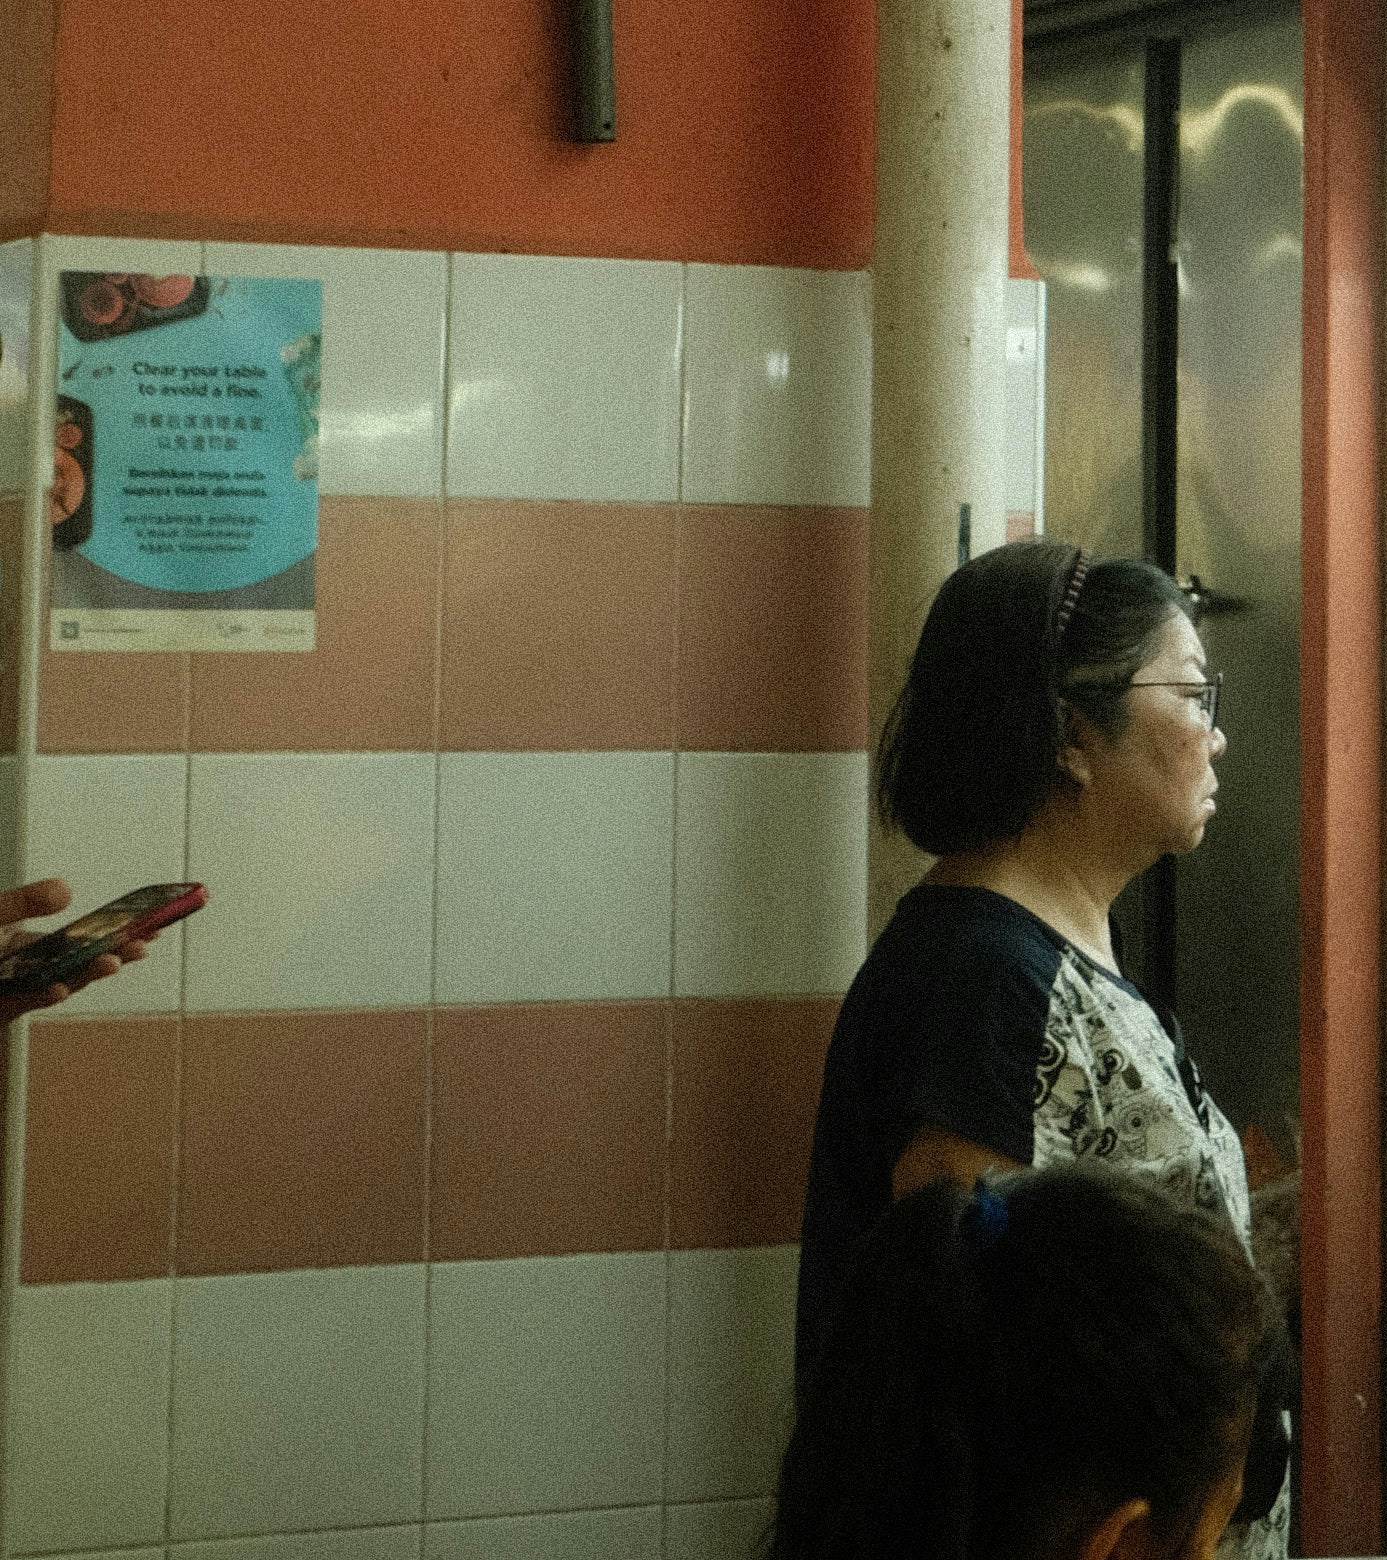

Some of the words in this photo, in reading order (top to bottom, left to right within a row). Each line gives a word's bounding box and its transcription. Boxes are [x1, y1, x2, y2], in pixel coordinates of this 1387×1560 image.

[132, 362, 177, 376] Clear
[181, 366, 219, 380] your
[223, 365, 267, 379] table
[138, 383, 157, 396] to
[161, 383, 208, 397] avoid
[211, 387, 223, 397] a
